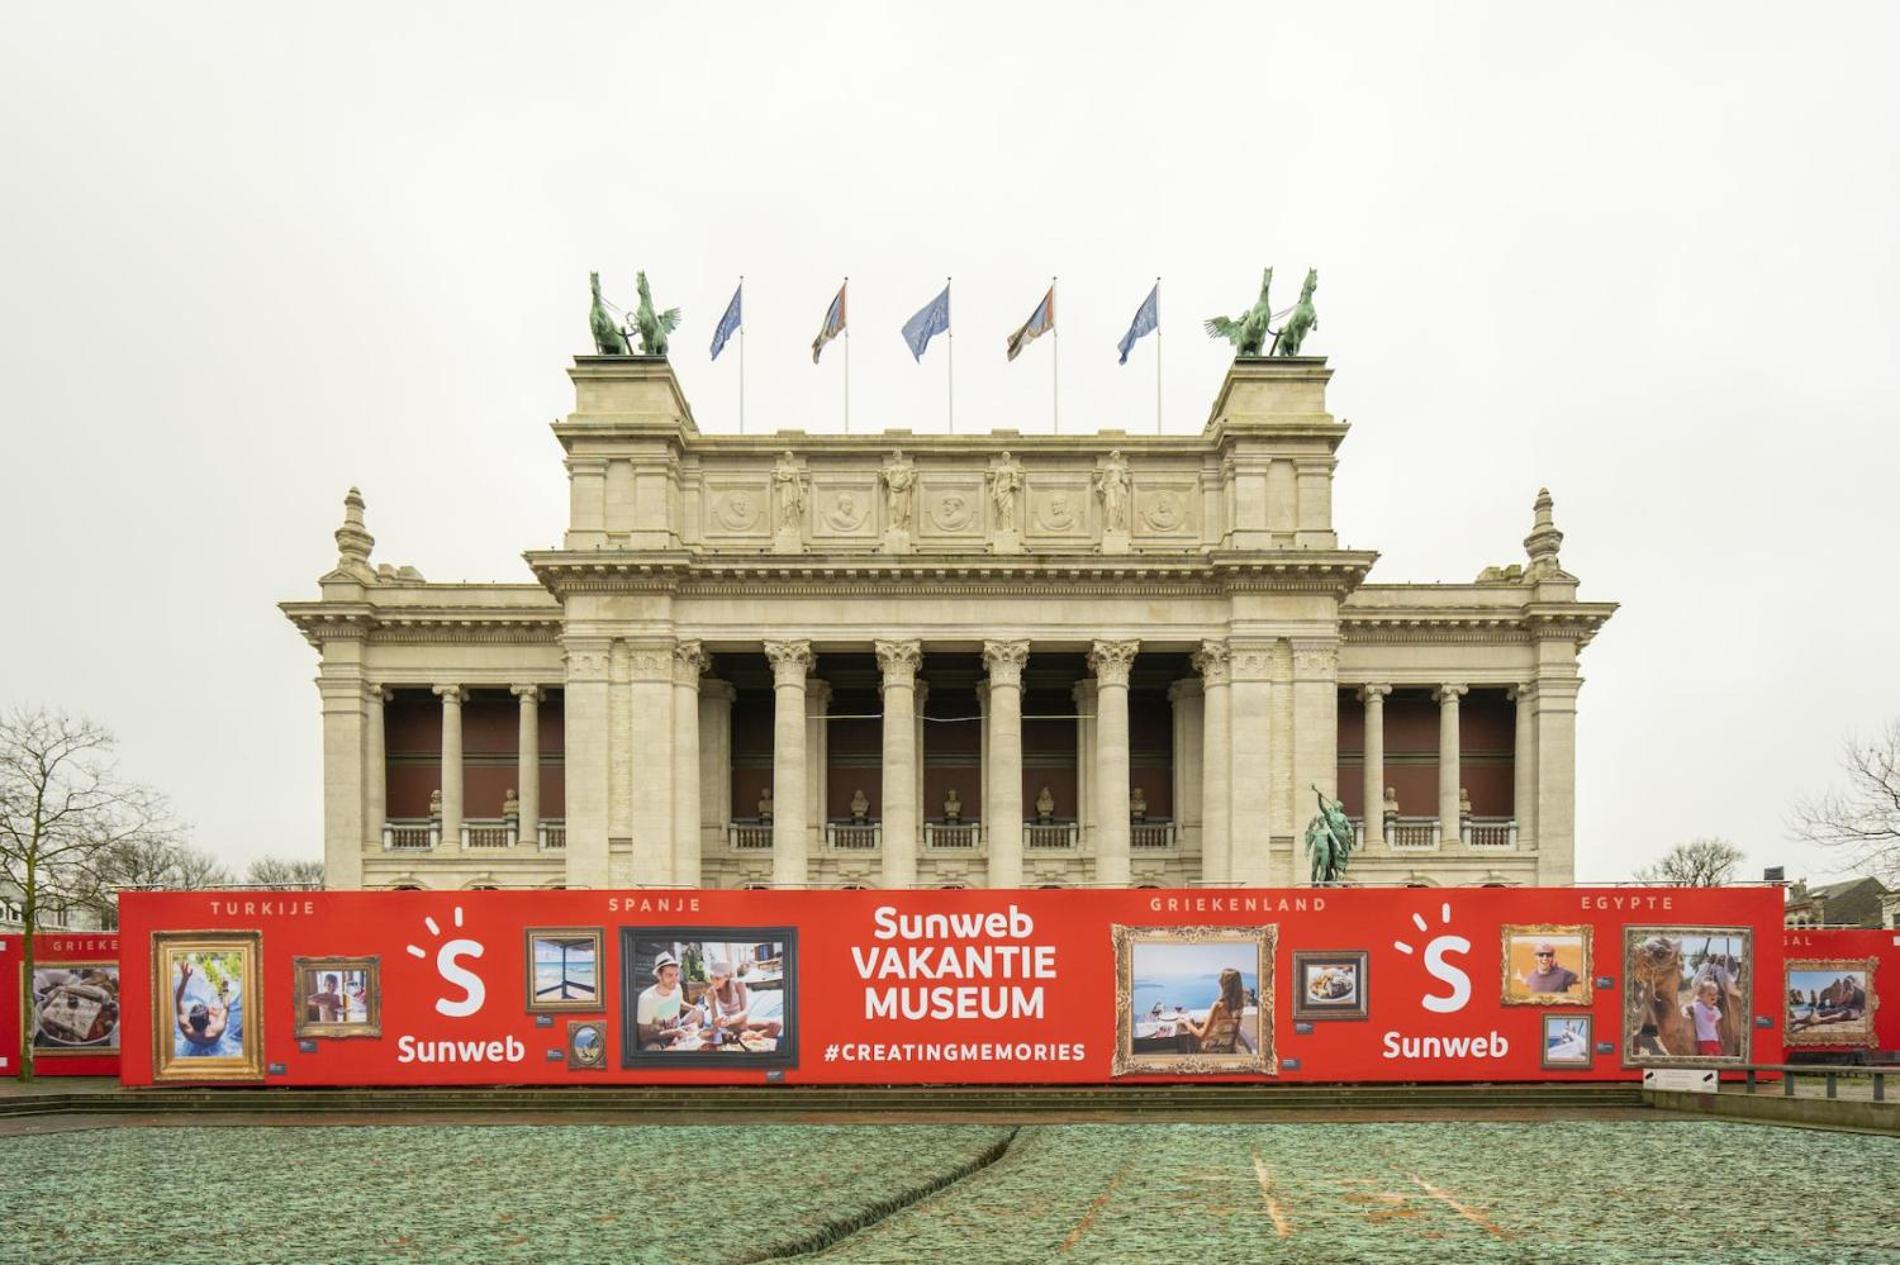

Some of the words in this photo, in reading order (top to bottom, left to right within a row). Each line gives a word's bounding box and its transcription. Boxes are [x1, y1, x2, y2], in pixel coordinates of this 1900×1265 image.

[210, 901, 314, 916] TURKIJE
[608, 897, 700, 912] SPANJE
[1149, 897, 1325, 912] GRIEKENLAND
[1581, 896, 1673, 910] EGYPTE
[874, 904, 1034, 940] Sunweb
[851, 946, 1057, 979] VAKANTIE
[865, 986, 1044, 1021] MUSEUM
[398, 1034, 525, 1063] Sunweb
[824, 1042, 1085, 1062] #CREATINGMEMORIES
[1382, 1030, 1509, 1059] Sunweb
